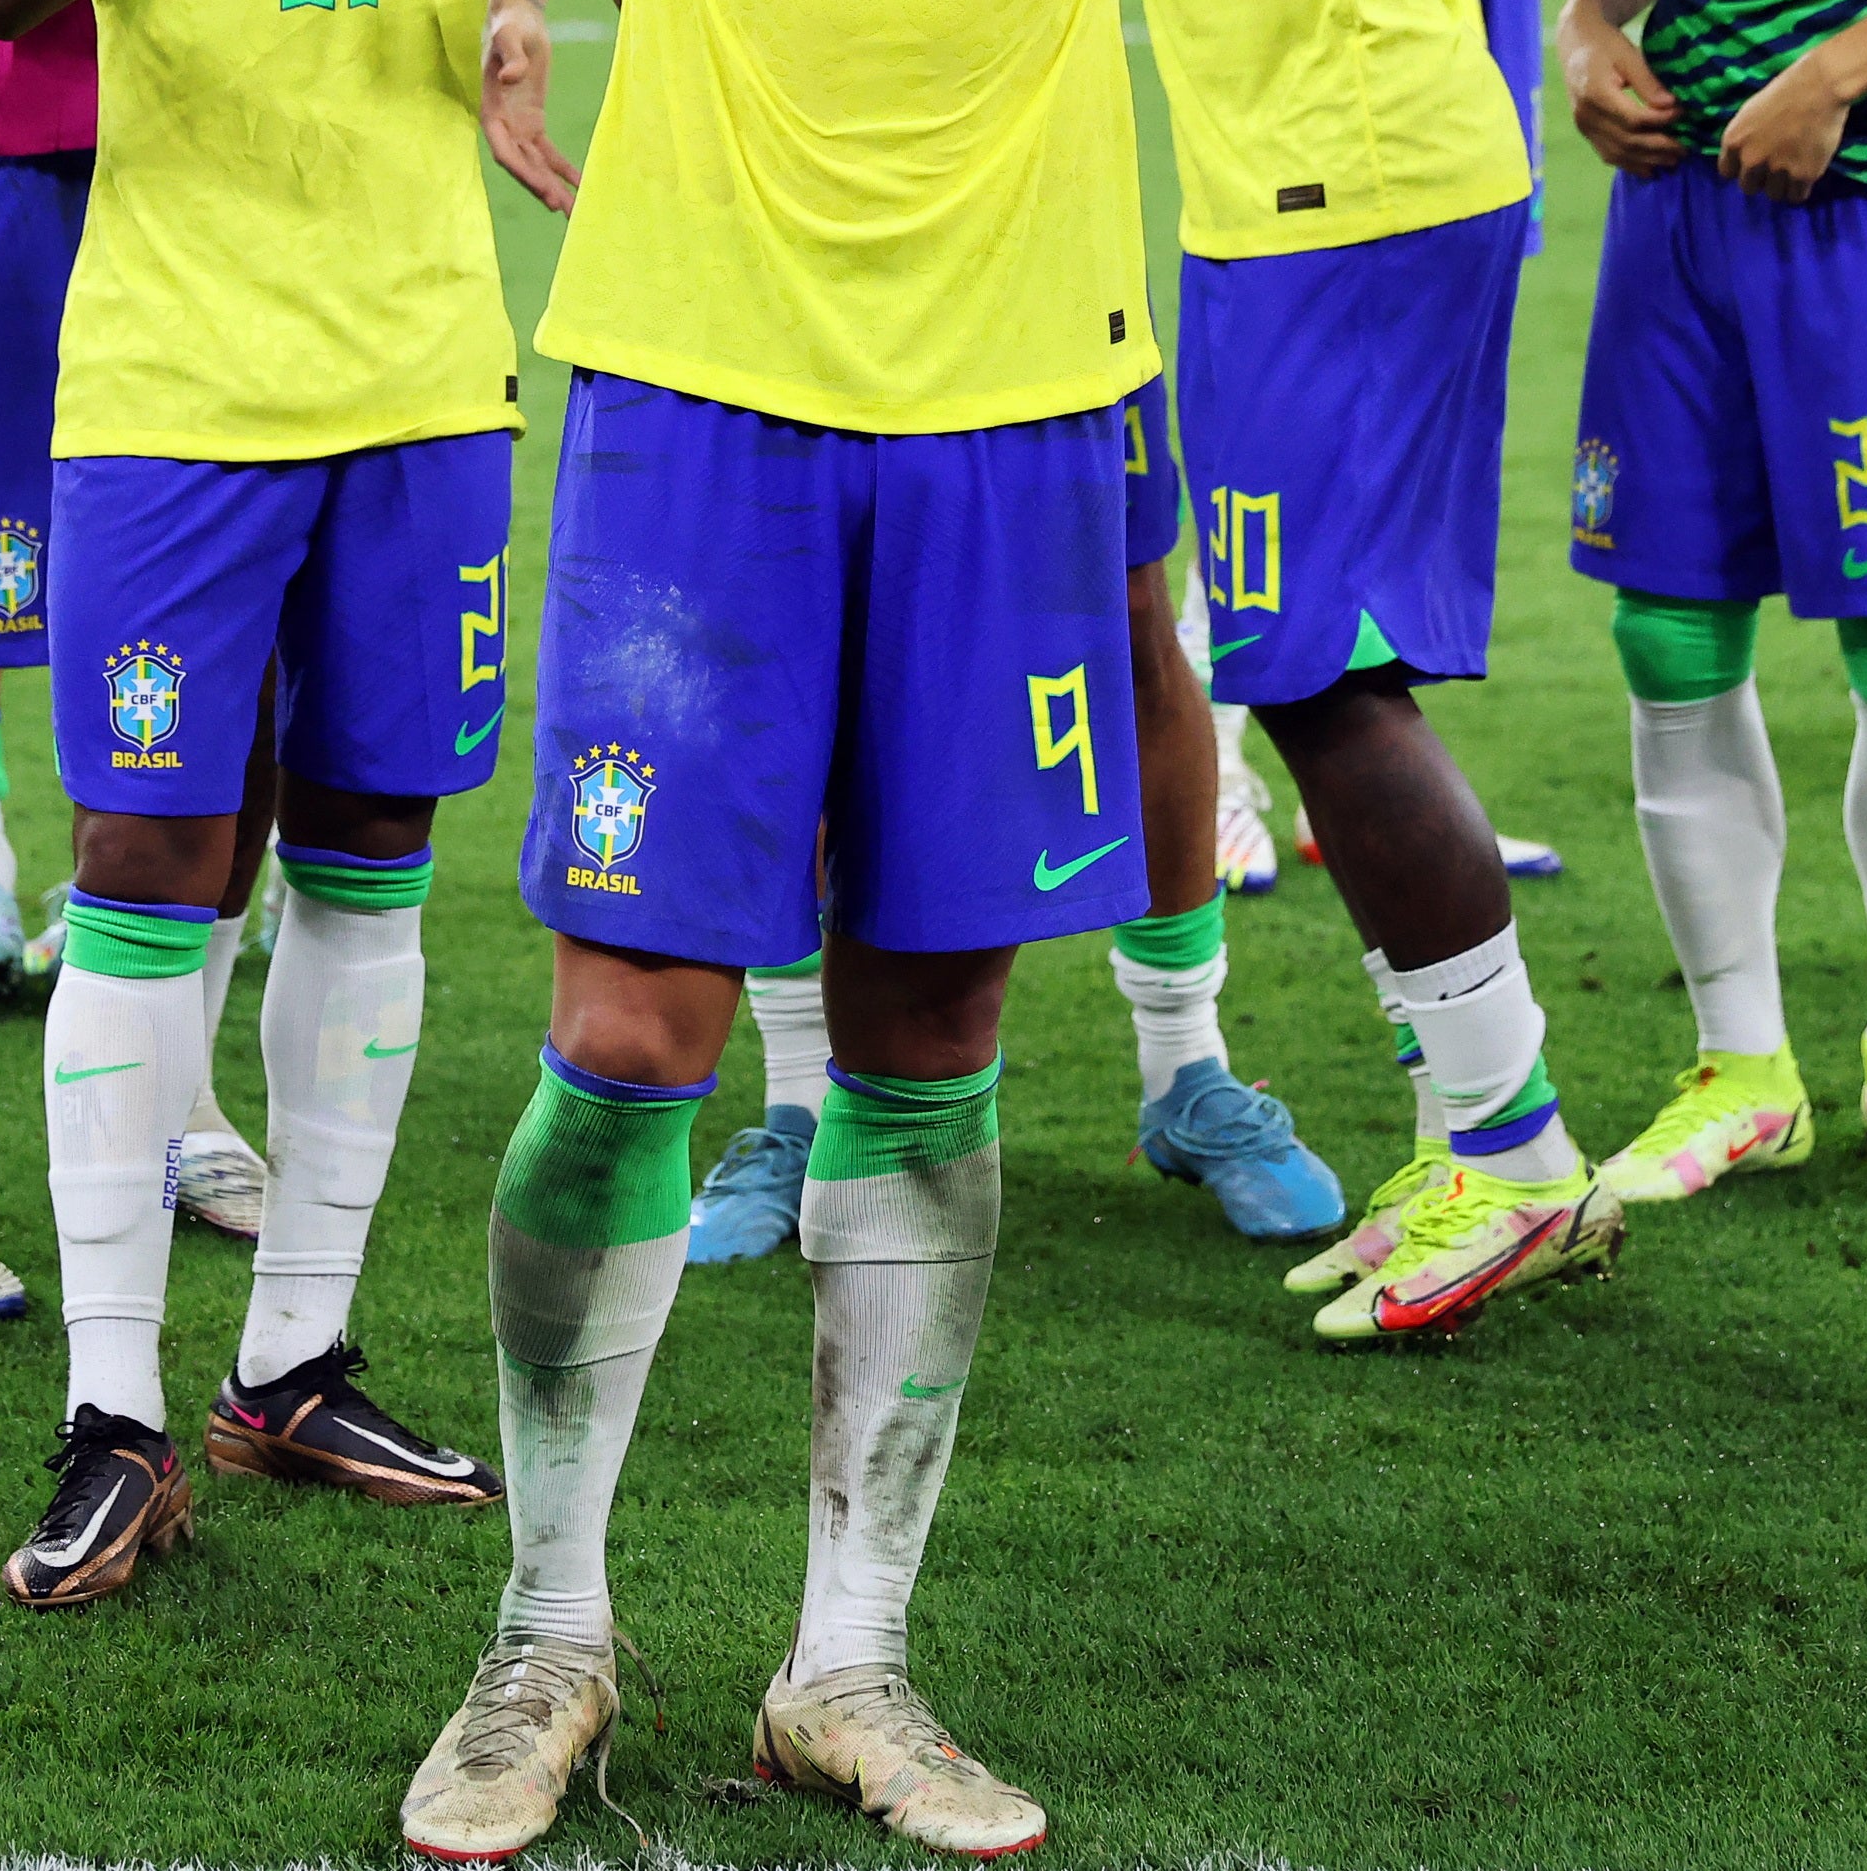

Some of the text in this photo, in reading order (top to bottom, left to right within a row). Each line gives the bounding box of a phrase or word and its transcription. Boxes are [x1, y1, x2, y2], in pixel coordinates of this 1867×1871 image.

[130, 694, 158, 705] CBF
[1026, 661, 1100, 817] 9
[111, 750, 184, 769] BRASIL
[595, 803, 624, 818] CBF
[566, 865, 643, 896] BRASIL
